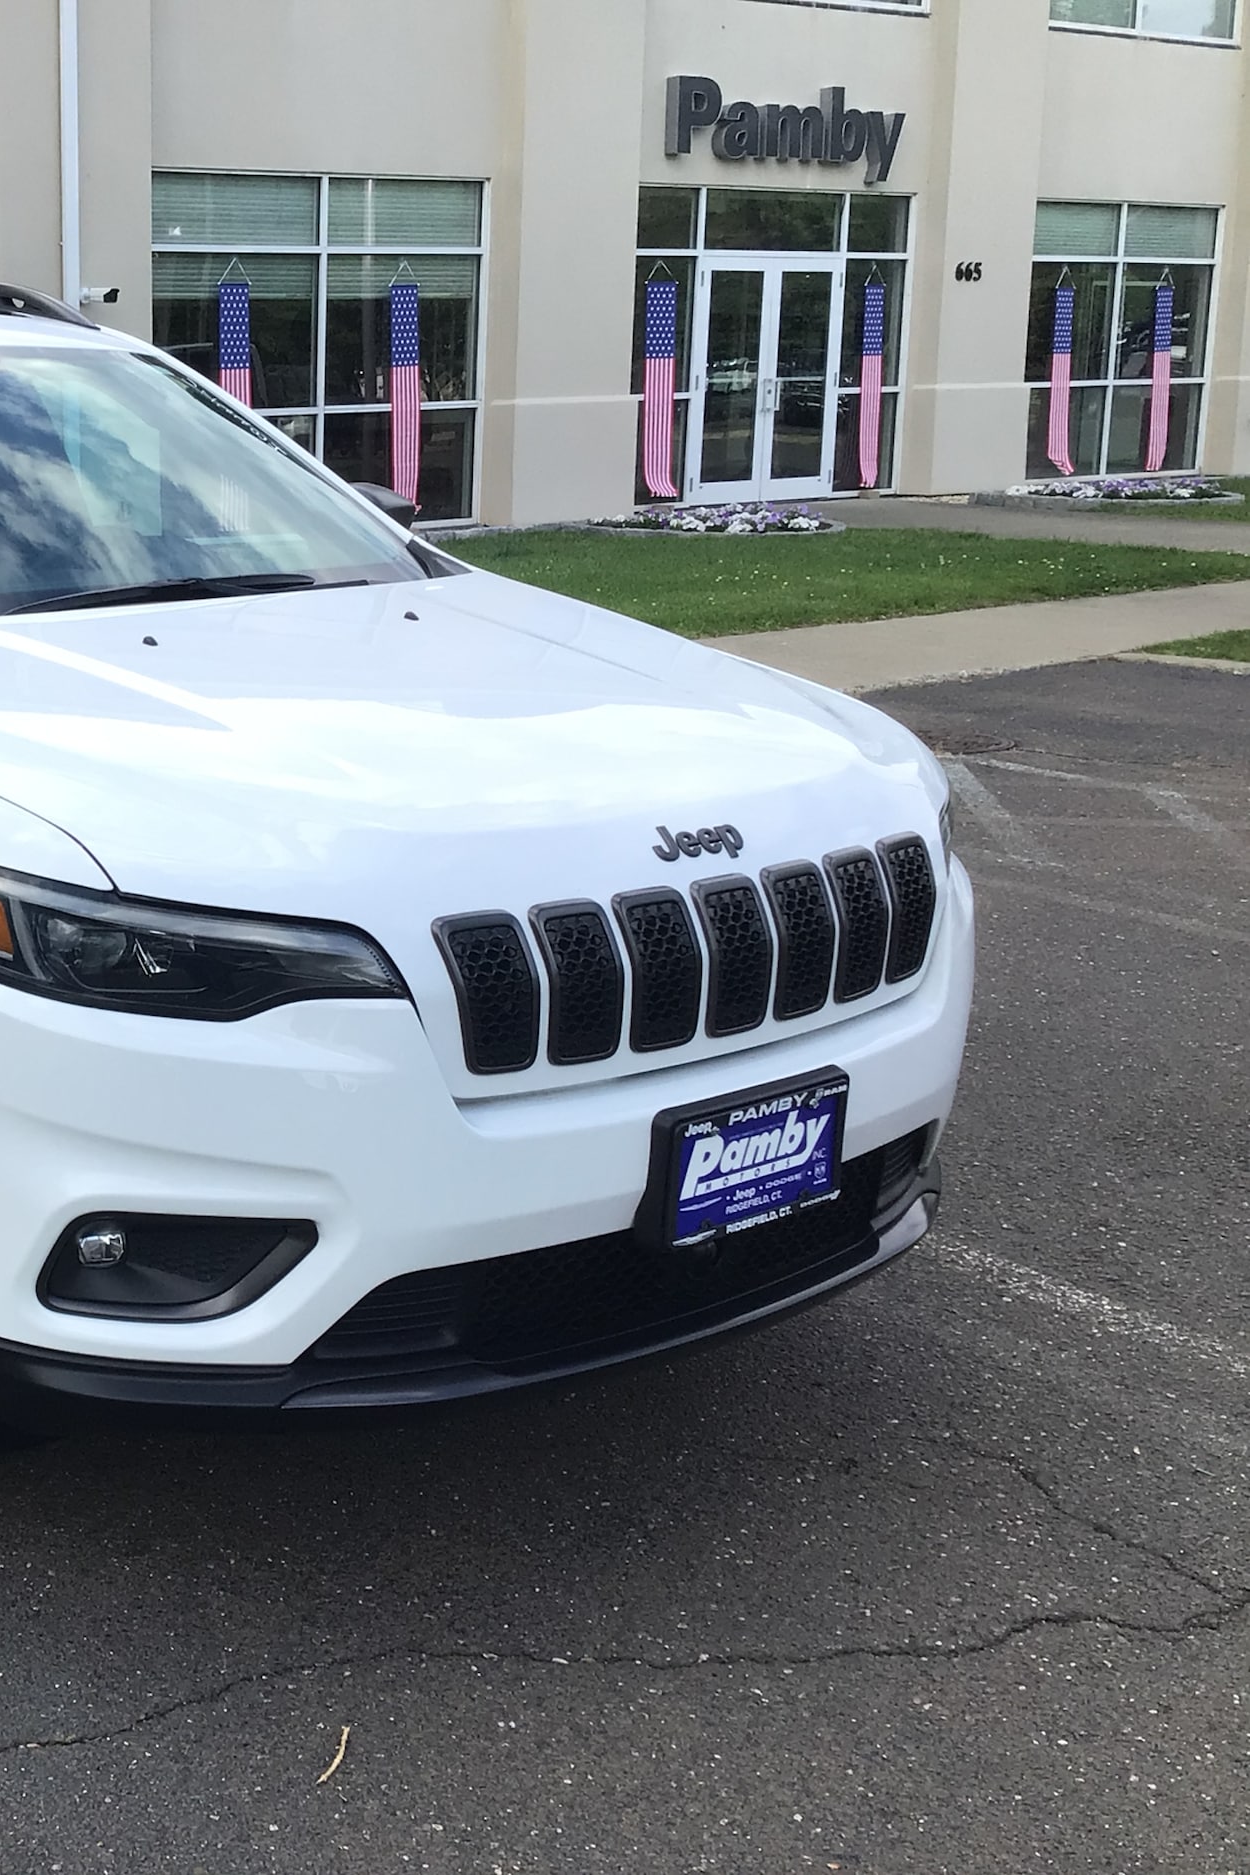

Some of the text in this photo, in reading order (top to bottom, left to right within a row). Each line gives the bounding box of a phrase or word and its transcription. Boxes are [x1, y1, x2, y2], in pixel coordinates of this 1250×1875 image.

[664, 75, 906, 184] Pamby
[955, 261, 983, 282] 665
[652, 824, 744, 862] Jeep
[728, 1092, 808, 1126] PAMBY
[684, 1121, 712, 1137] Jeep
[679, 1110, 831, 1201] Pamby
[704, 1158, 790, 1191] MOTORS
[765, 1173, 802, 1189] DODGE
[733, 1187, 756, 1201] Jeep
